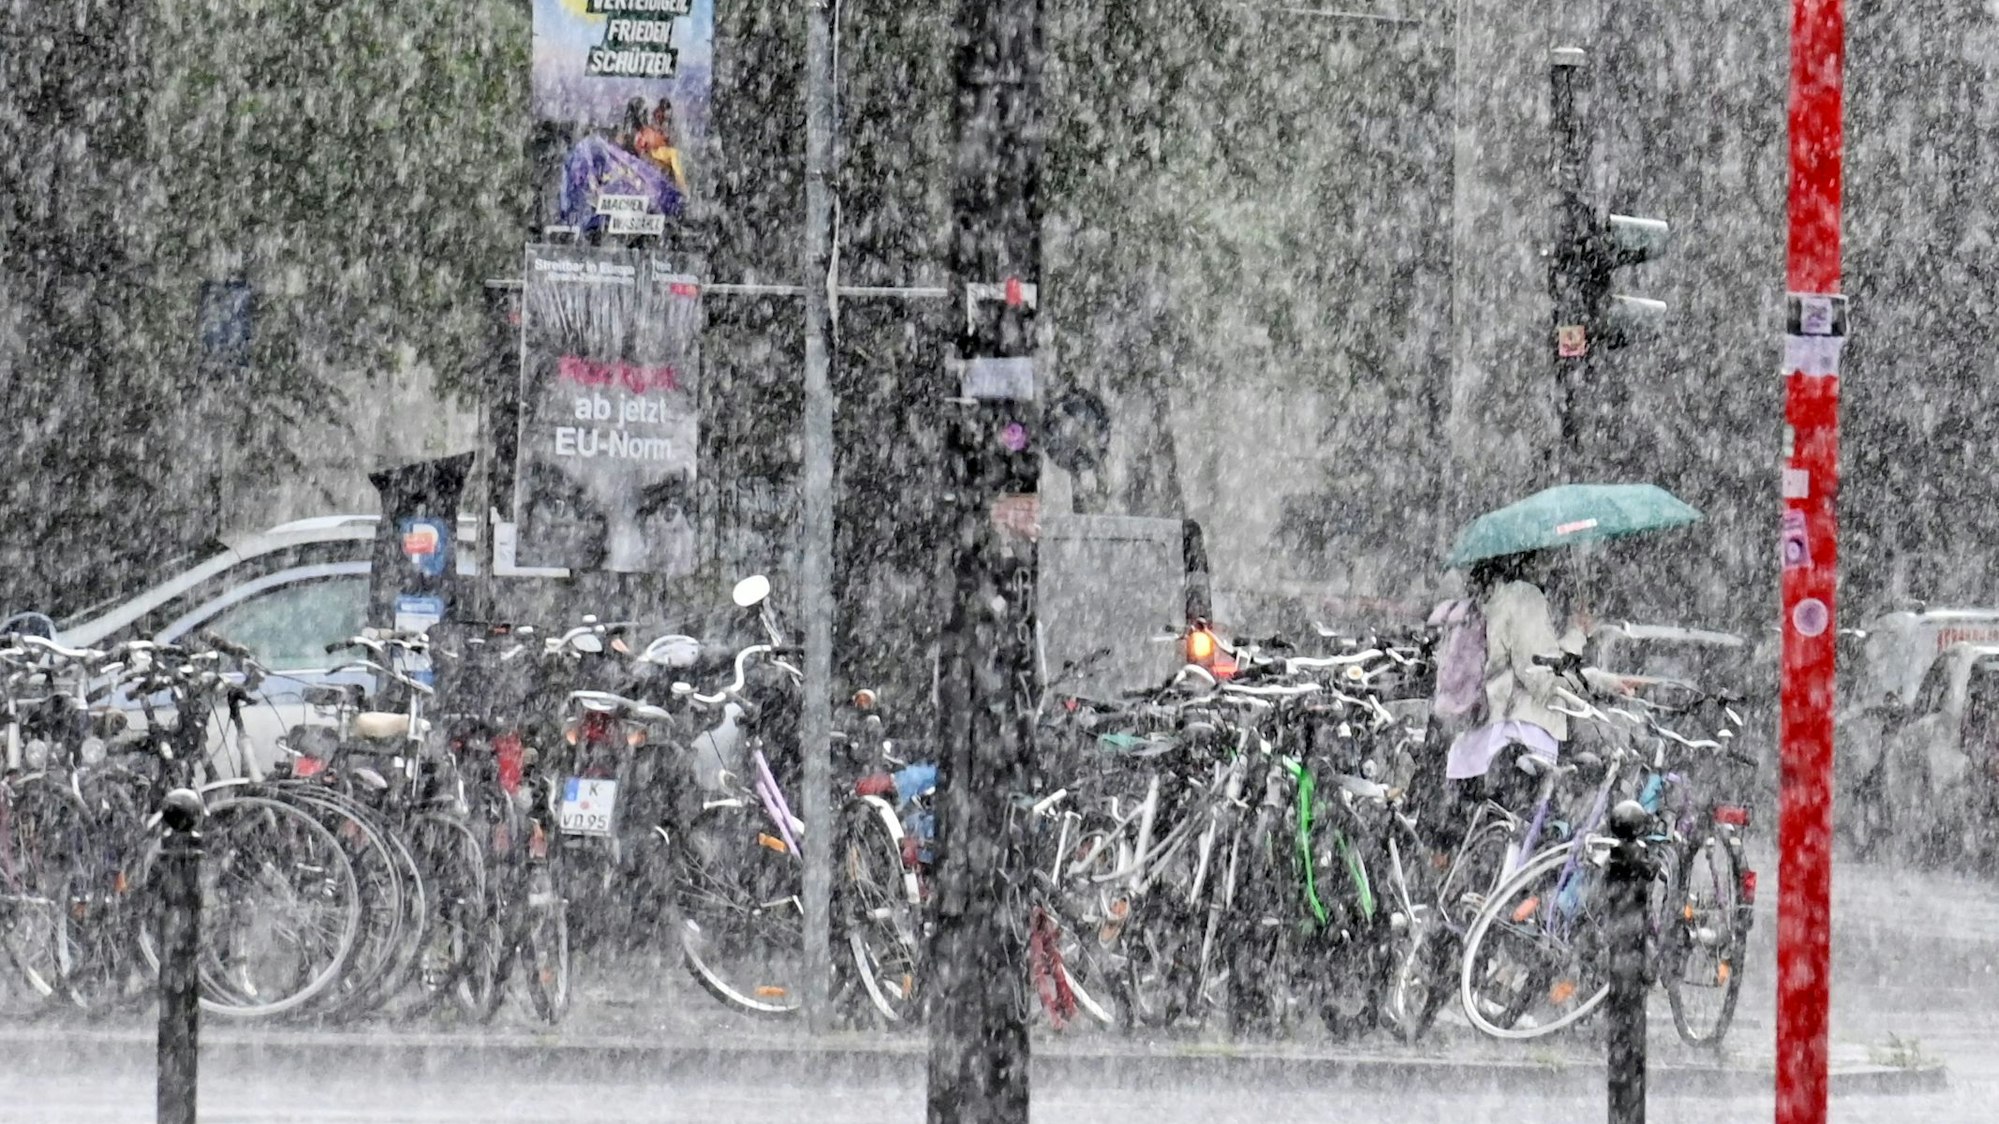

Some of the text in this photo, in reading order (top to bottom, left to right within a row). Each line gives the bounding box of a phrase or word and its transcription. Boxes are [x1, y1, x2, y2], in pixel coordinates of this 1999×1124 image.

[607, 18, 671, 43] FRIEDEN
[590, 47, 673, 75] SCHÜTZEN.
[574, 393, 667, 427] ab jetzt
[588, 782, 600, 796] K
[587, 814, 607, 829] 95
